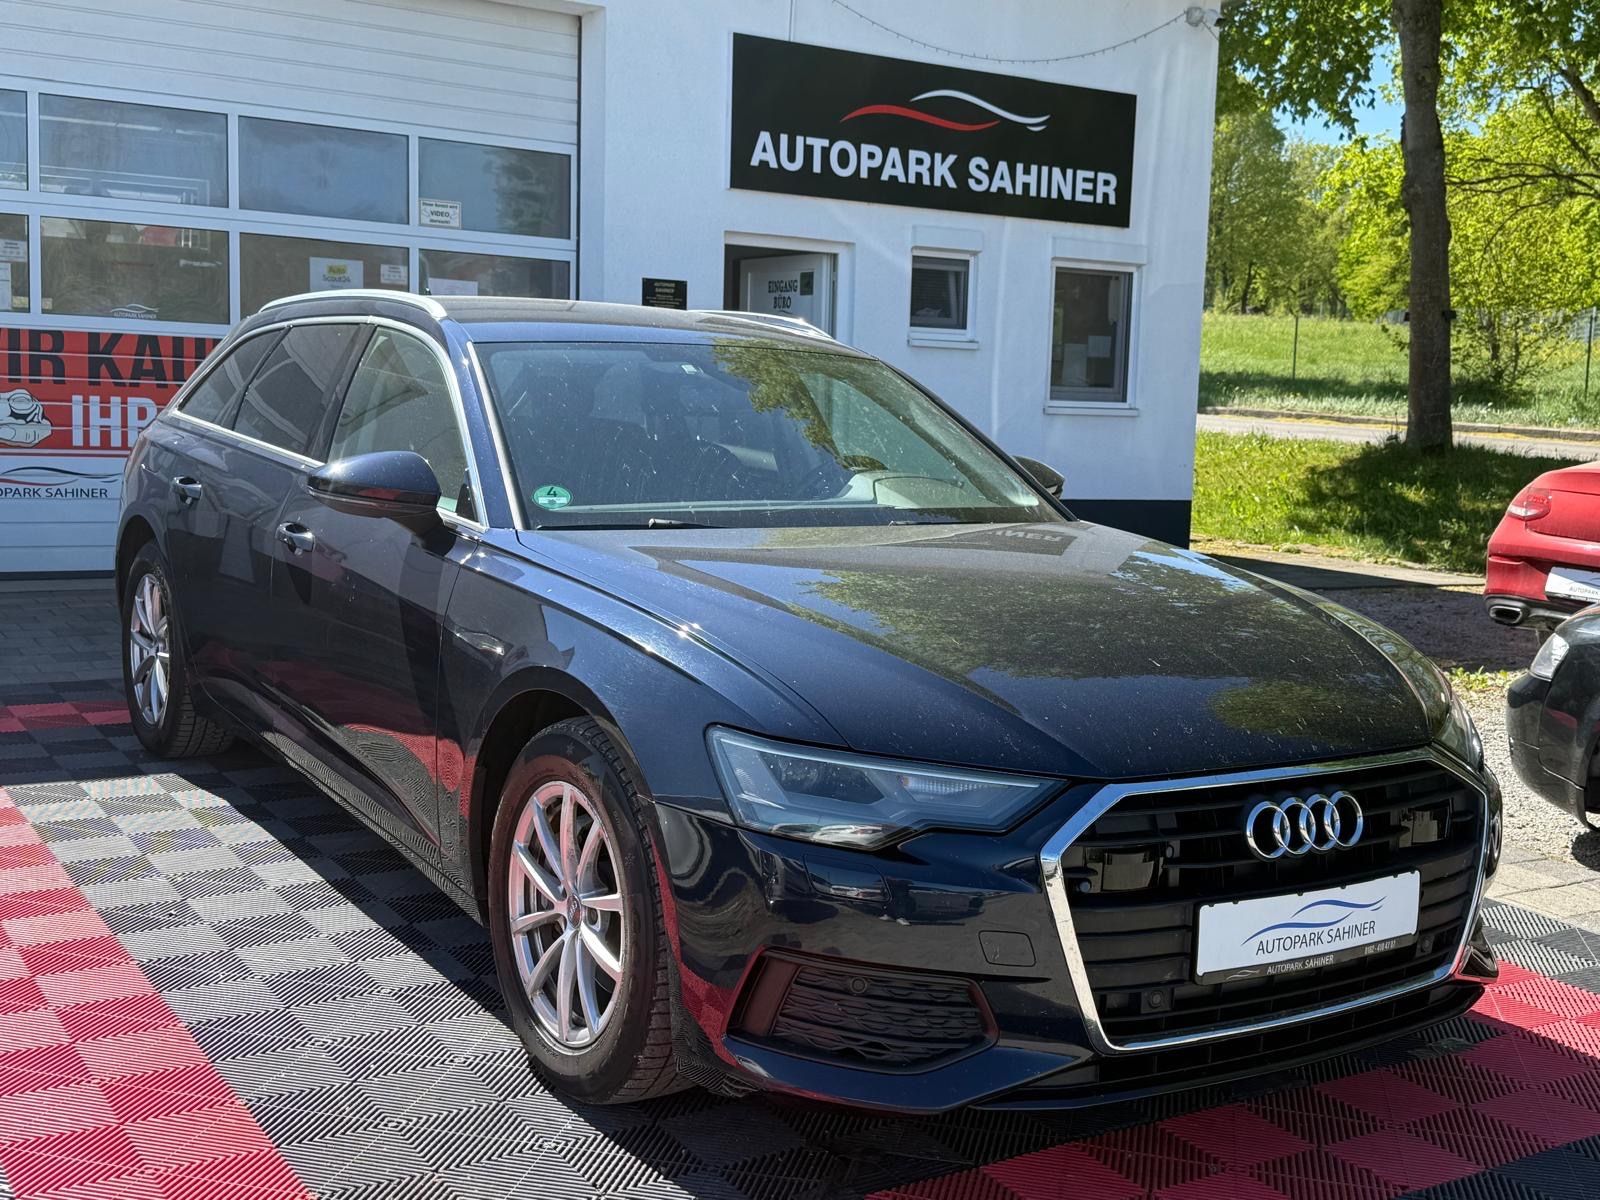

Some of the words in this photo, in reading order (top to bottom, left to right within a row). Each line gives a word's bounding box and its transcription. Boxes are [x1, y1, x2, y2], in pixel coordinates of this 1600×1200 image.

[750, 131, 957, 189] AUTOPARK
[967, 156, 1118, 205] SAHINER
[430, 210, 450, 218] VIDEO
[768, 280, 798, 293] EINGANG
[773, 294, 792, 309] BÜRO
[0, 328, 66, 385] IR
[87, 332, 223, 389] KAU
[45, 487, 108, 498] SAHINER
[546, 486, 557, 498] 4
[1256, 930, 1325, 956] AUTOPARK
[1327, 921, 1376, 944] SAHINER
[1267, 962, 1303, 975] AUTOPARK
[1304, 954, 1334, 969] SAHINER
